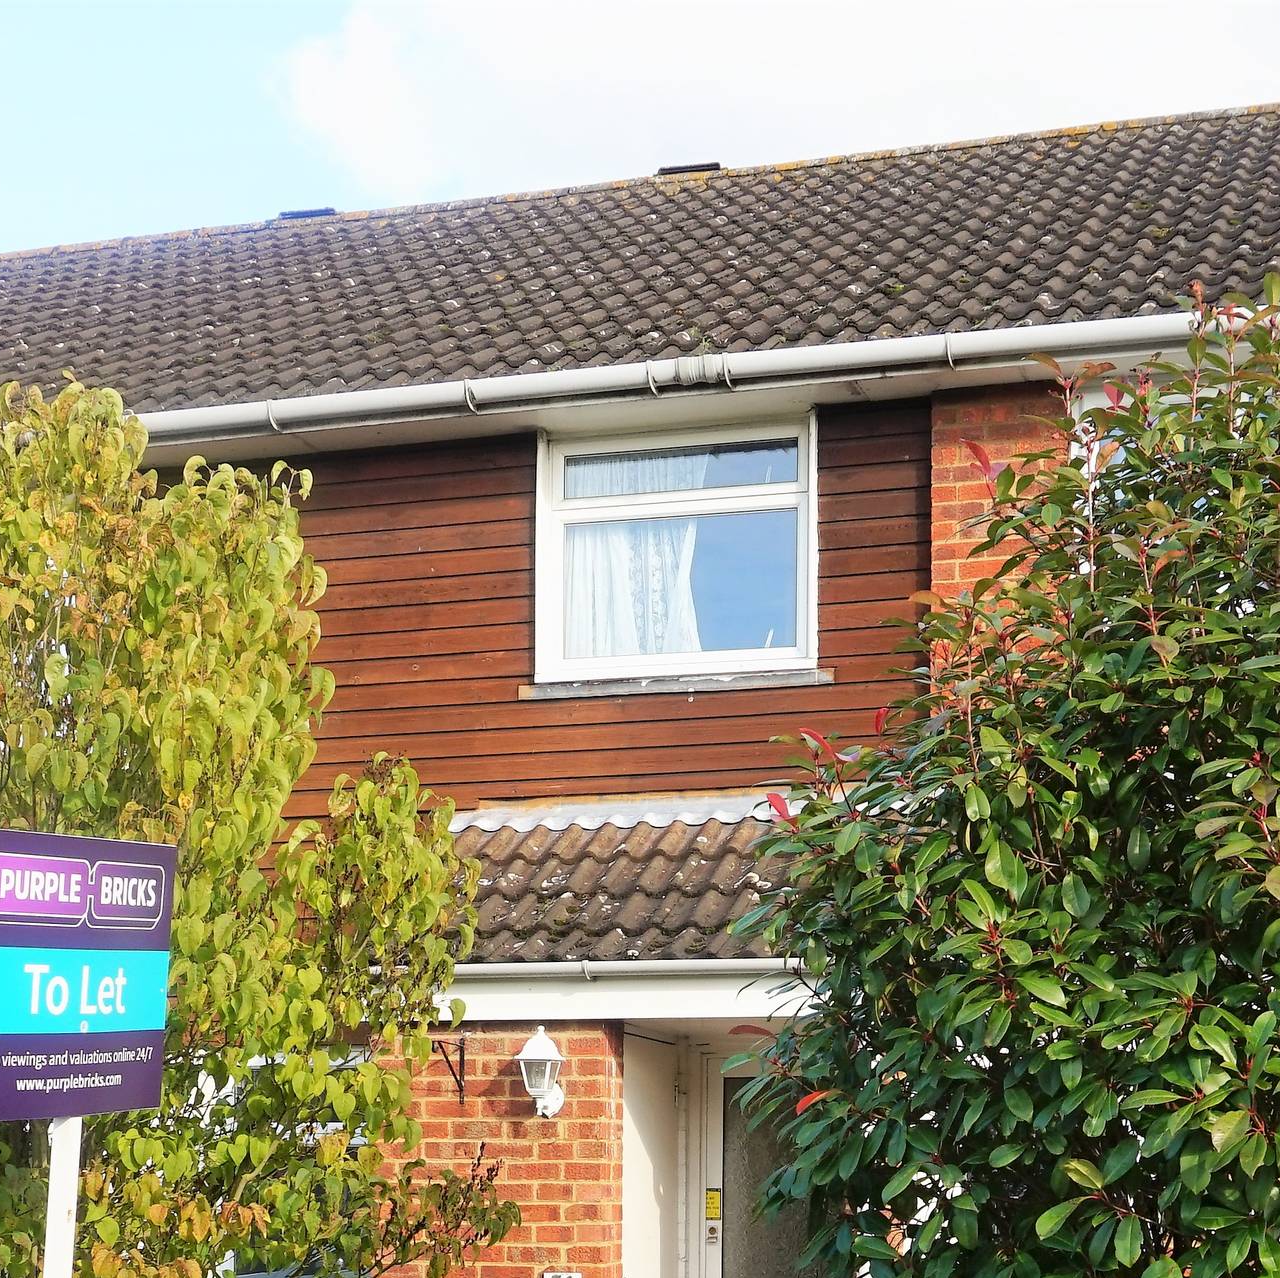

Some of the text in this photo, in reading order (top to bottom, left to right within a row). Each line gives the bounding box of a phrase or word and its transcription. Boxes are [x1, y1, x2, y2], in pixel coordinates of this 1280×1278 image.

[0, 868, 157, 907] PURPLE BRICKS
[23, 963, 128, 1016] To Let
[1, 1051, 48, 1071] viewings
[48, 1050, 69, 1066] and
[69, 1049, 113, 1065] valuations
[113, 1047, 136, 1063] online
[135, 1046, 154, 1063] 24/7
[16, 1072, 122, 1093] www.purplebricks.com
